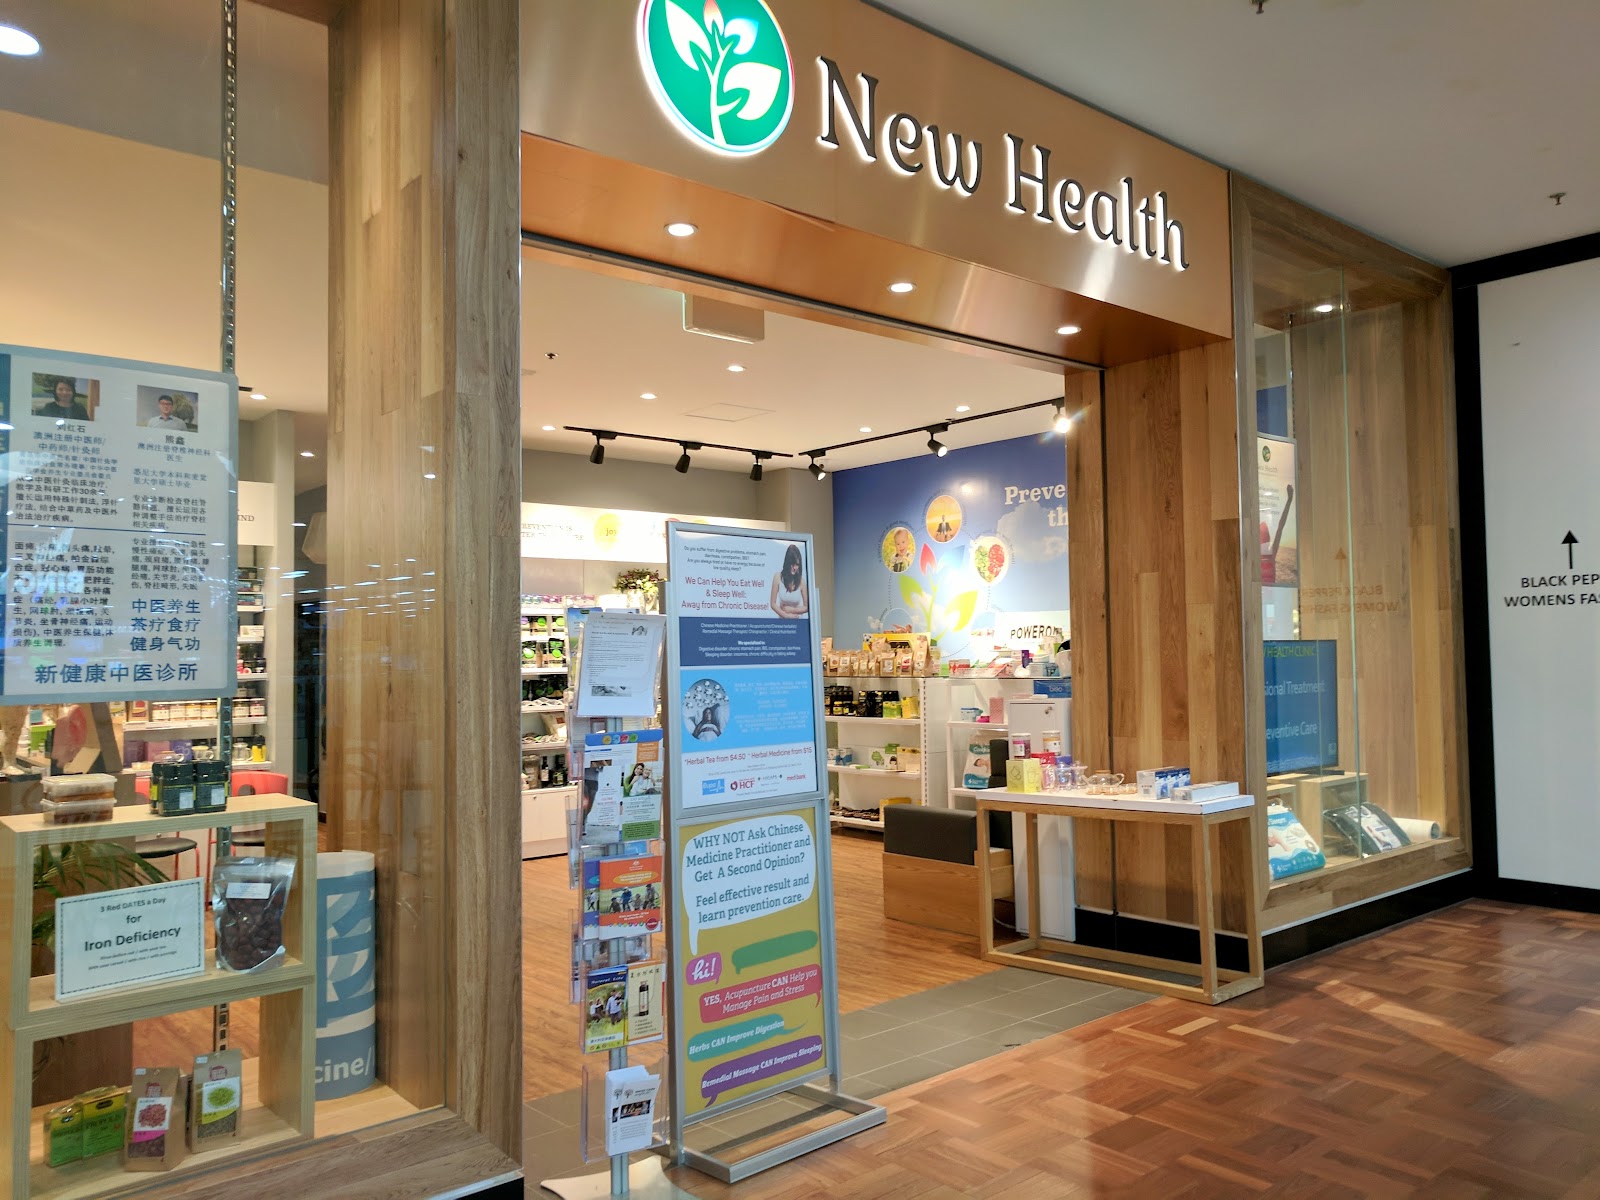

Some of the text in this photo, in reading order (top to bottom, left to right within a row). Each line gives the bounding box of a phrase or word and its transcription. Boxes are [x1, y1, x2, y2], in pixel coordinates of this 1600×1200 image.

[815, 55, 1190, 272] New Health
[1004, 484, 1066, 505] Preve
[685, 577, 764, 588] We Can Help You Eat Well
[1520, 573, 1600, 588] BLACK PEP
[706, 589, 711, 597] &
[712, 590, 730, 599] Sleep
[1503, 594, 1576, 607] WOMENS
[131, 598, 201, 614] 中医养生
[681, 601, 769, 611] Away from Chronic Disease!
[131, 617, 201, 632] 茶疗食疗
[130, 636, 201, 652] 健身气功
[1268, 646, 1294, 658] HEALTH
[34, 663, 199, 684] 新健康中医诊所
[1286, 680, 1326, 695] Treatment
[1300, 721, 1318, 736] Care
[751, 751, 767, 759] Herbal
[769, 749, 790, 757] Medicine
[739, 780, 755, 790] HCF
[693, 823, 804, 850] WHY NOT Ask Chinese
[686, 835, 811, 867] Medicine Practitioner and
[694, 852, 805, 882] Get A Second Opinion?
[696, 874, 809, 907] Feel effective result and
[123, 900, 146, 909] DATES
[152, 897, 166, 905] Day
[698, 892, 804, 923] learn prevention care.
[126, 915, 142, 924] for
[84, 927, 181, 952] Iron Deficiency
[692, 957, 717, 981] hi!
[703, 968, 818, 1007] YES, Acupuncture CAN Help you
[722, 984, 805, 1014] Manage Pain and Stress
[689, 1020, 785, 1055] Herbs CAN Improve Digestion
[702, 1042, 823, 1089] Remedial Massage CAN Improve Sleeping
